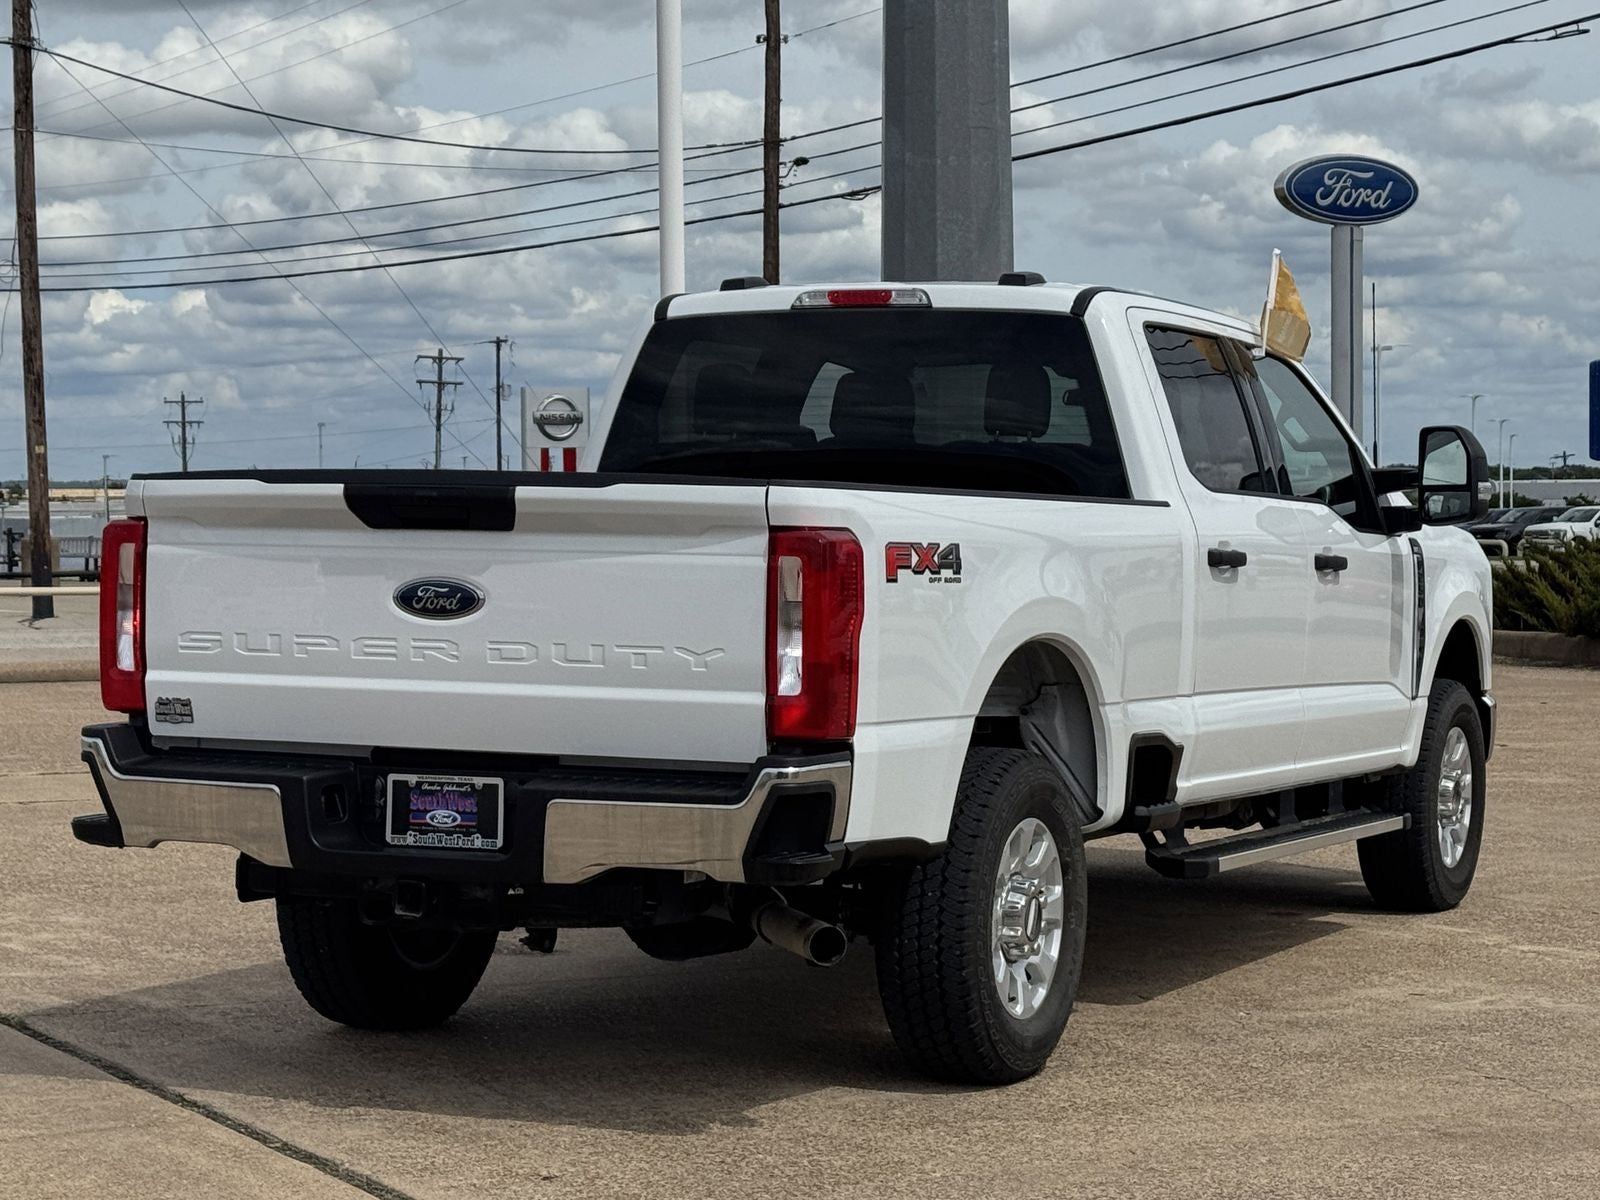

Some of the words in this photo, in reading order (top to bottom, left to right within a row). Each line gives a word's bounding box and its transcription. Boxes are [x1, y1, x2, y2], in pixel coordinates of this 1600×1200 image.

[1315, 168, 1394, 209] Ford
[540, 413, 580, 421] NISSAN
[885, 542, 962, 583] FX4
[412, 585, 462, 610] Ford
[177, 630, 462, 664] SUPER
[486, 639, 726, 672] DUTY
[433, 813, 454, 824] Ford
